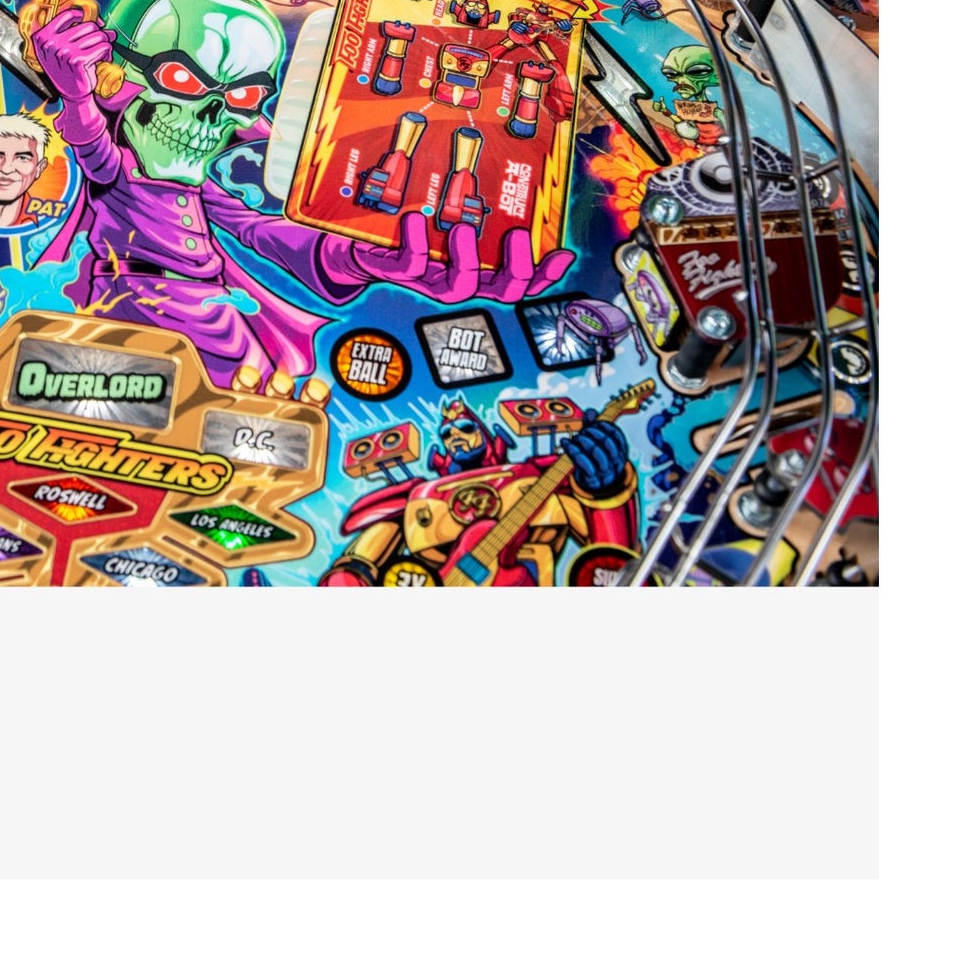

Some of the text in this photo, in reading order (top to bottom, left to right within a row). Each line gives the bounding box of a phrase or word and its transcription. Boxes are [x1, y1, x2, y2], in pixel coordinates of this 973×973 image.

[434, 0, 445, 17] HEAD
[336, 28, 363, 70] FOO
[361, 37, 378, 74] RIGHT ARM
[423, 55, 435, 78] CHEST
[500, 73, 514, 106] LEFT ARM
[344, 147, 360, 186] RIGHT LEG
[427, 172, 441, 206] LEFT LEG
[513, 162, 532, 220] CONSTRUCT
[27, 200, 66, 220] PAT
[447, 326, 485, 350] BOT
[351, 341, 393, 364] EXTRA
[438, 349, 487, 372] AWARD
[17, 361, 166, 403] OVERLORD
[348, 360, 388, 386] BALL
[233, 427, 275, 453] D.C.
[25, 425, 230, 493] FIGHTERS
[33, 484, 108, 511] ROSWELL
[190, 512, 274, 539] LOS ANGELES
[104, 556, 181, 583] CHICAGO
